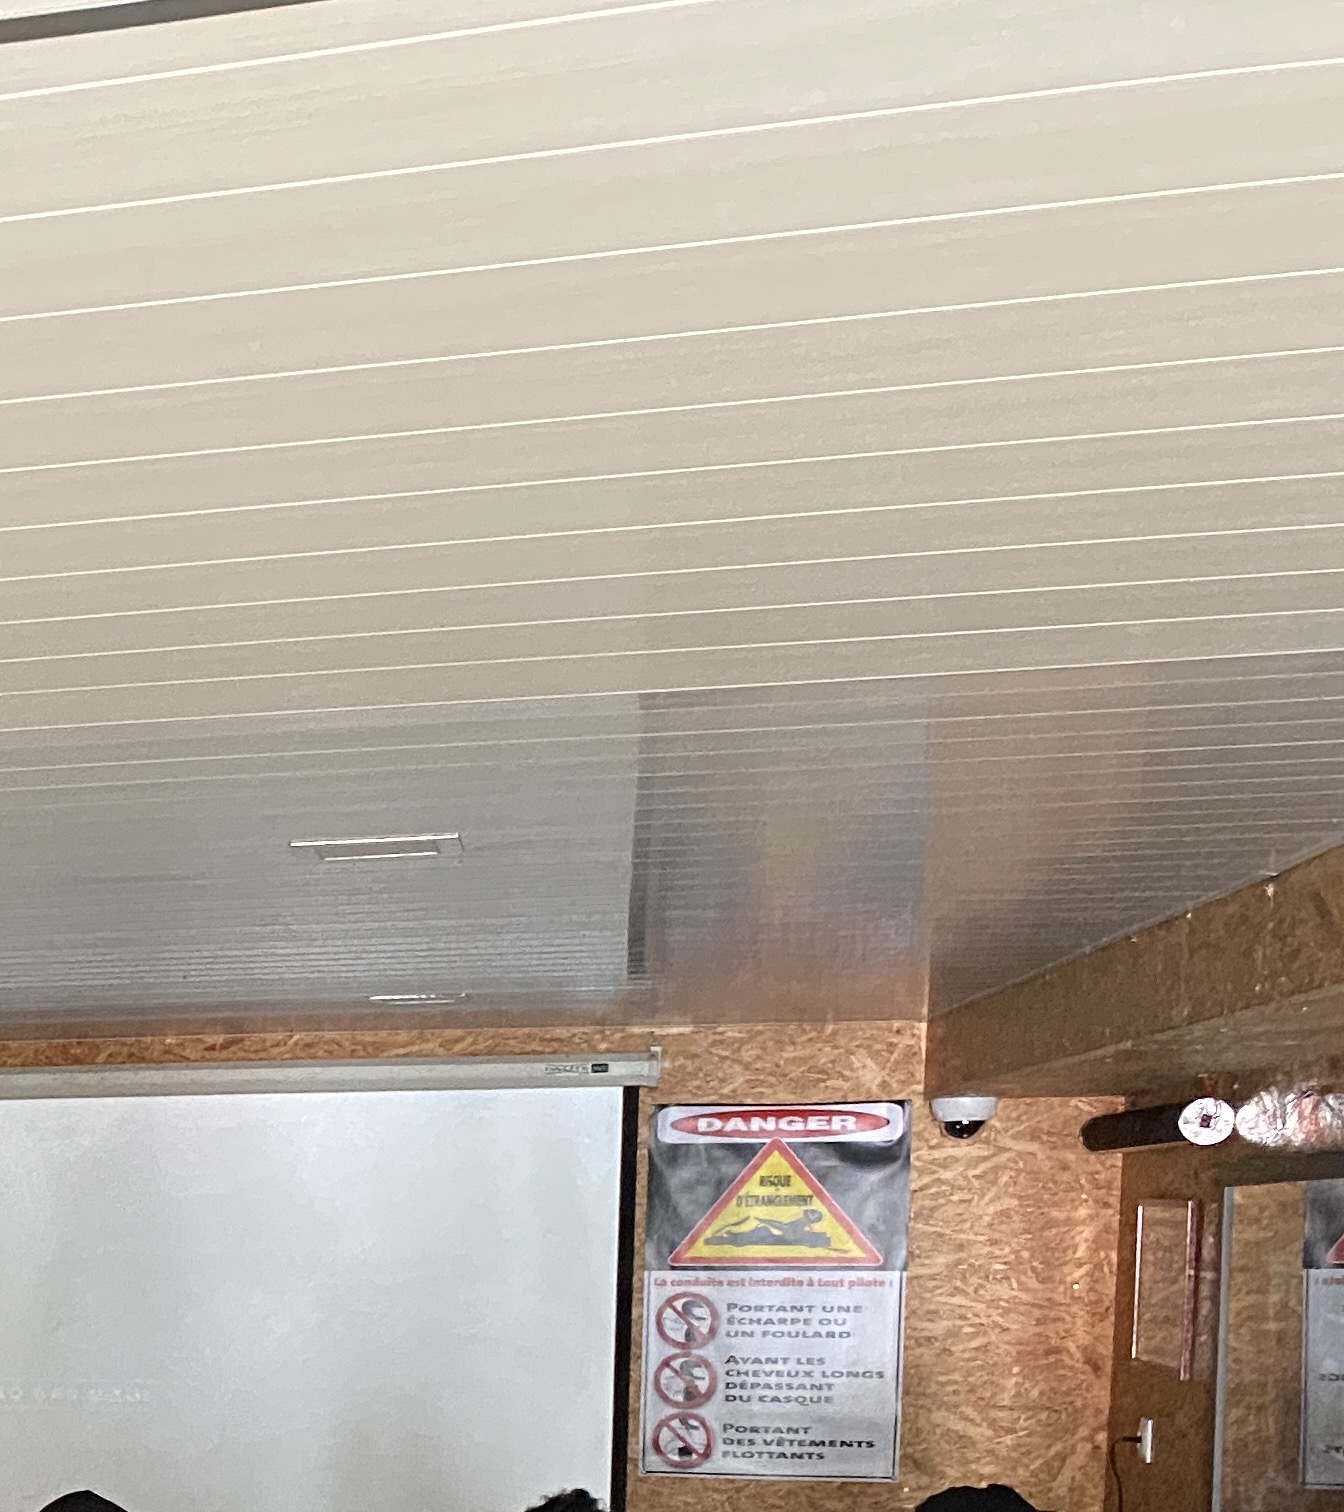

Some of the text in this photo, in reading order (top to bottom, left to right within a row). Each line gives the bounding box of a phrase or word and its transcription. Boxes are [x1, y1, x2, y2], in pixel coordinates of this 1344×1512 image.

[696, 1115, 857, 1133] DANGER
[759, 1174, 792, 1191] RISQUE
[670, 1277, 724, 1287] conduite
[726, 1278, 746, 1287] est
[748, 1277, 804, 1287] interdite
[817, 1278, 845, 1288] tout
[847, 1277, 886, 1289] pilote
[726, 1302, 863, 1314] PORTANT UNE
[726, 1315, 847, 1326] ÉCHARPE OU
[725, 1330, 852, 1339] UN FOULARD
[724, 1355, 826, 1365] AYANT LES
[725, 1369, 885, 1379] CHEVEUX LONGS
[724, 1380, 835, 1391] DÉPASSANT
[724, 1394, 835, 1406] DU CASQUE
[722, 1423, 813, 1435] PORTANT
[722, 1436, 876, 1449] DES VÊTEMENTS
[722, 1451, 826, 1461] FLOTTANTS
